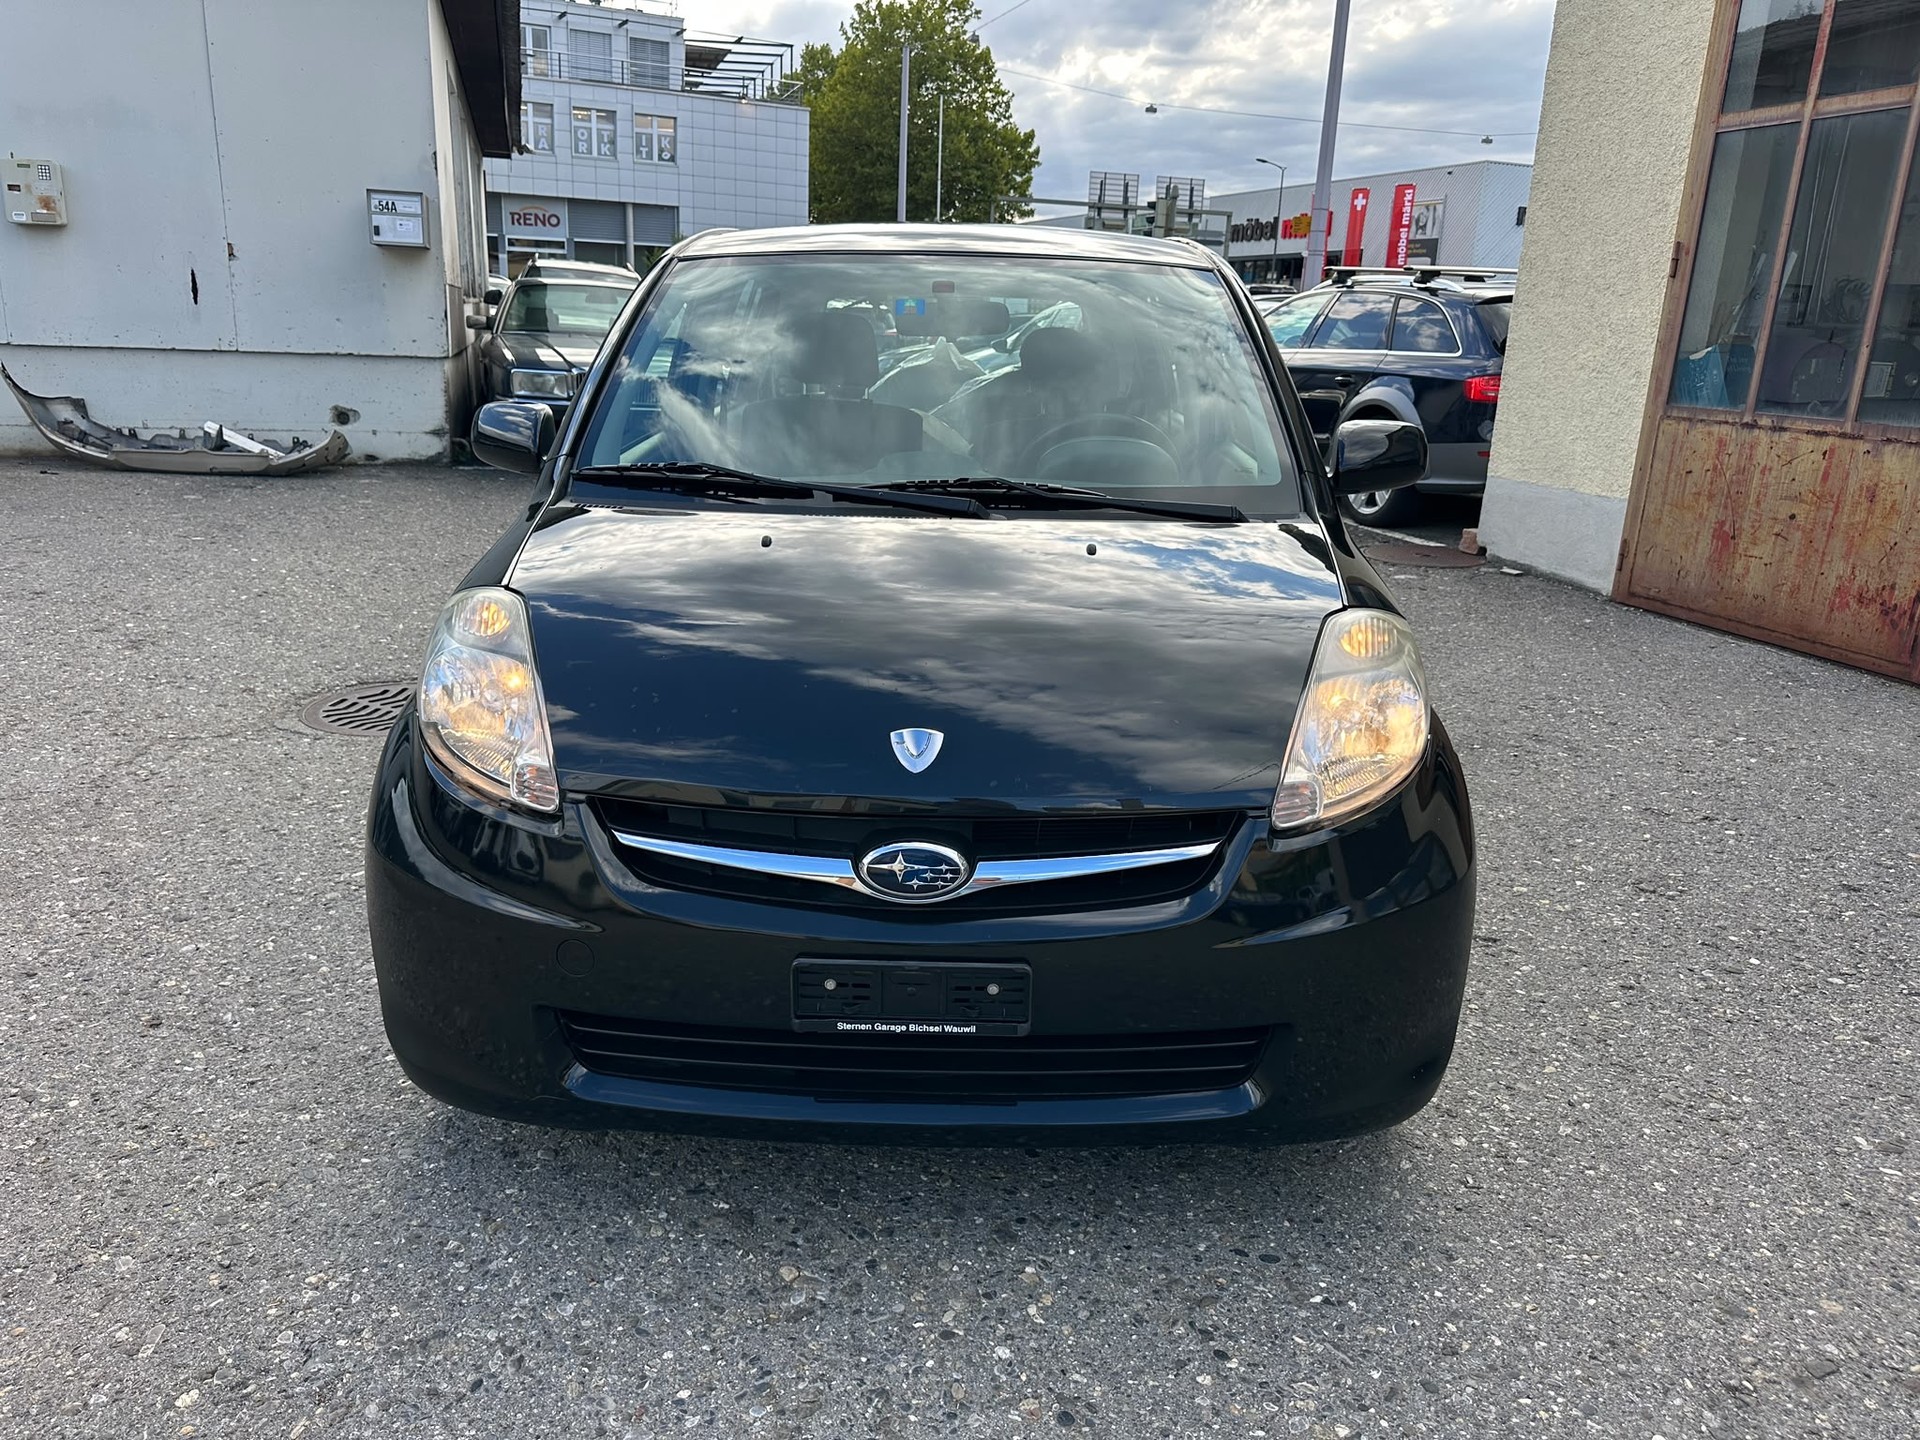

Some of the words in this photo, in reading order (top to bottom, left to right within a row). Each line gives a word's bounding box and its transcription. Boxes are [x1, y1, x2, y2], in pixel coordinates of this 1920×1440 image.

[378, 200, 398, 213] 54A
[1402, 188, 1414, 225] märki
[509, 211, 561, 228] RENO
[1230, 216, 1279, 243] möbel
[1397, 227, 1409, 266] möbel
[837, 1022, 872, 1031] Sternen
[874, 1022, 907, 1033] Garage
[909, 1024, 942, 1033] Bichsel
[944, 1025, 976, 1033] Wauwil
